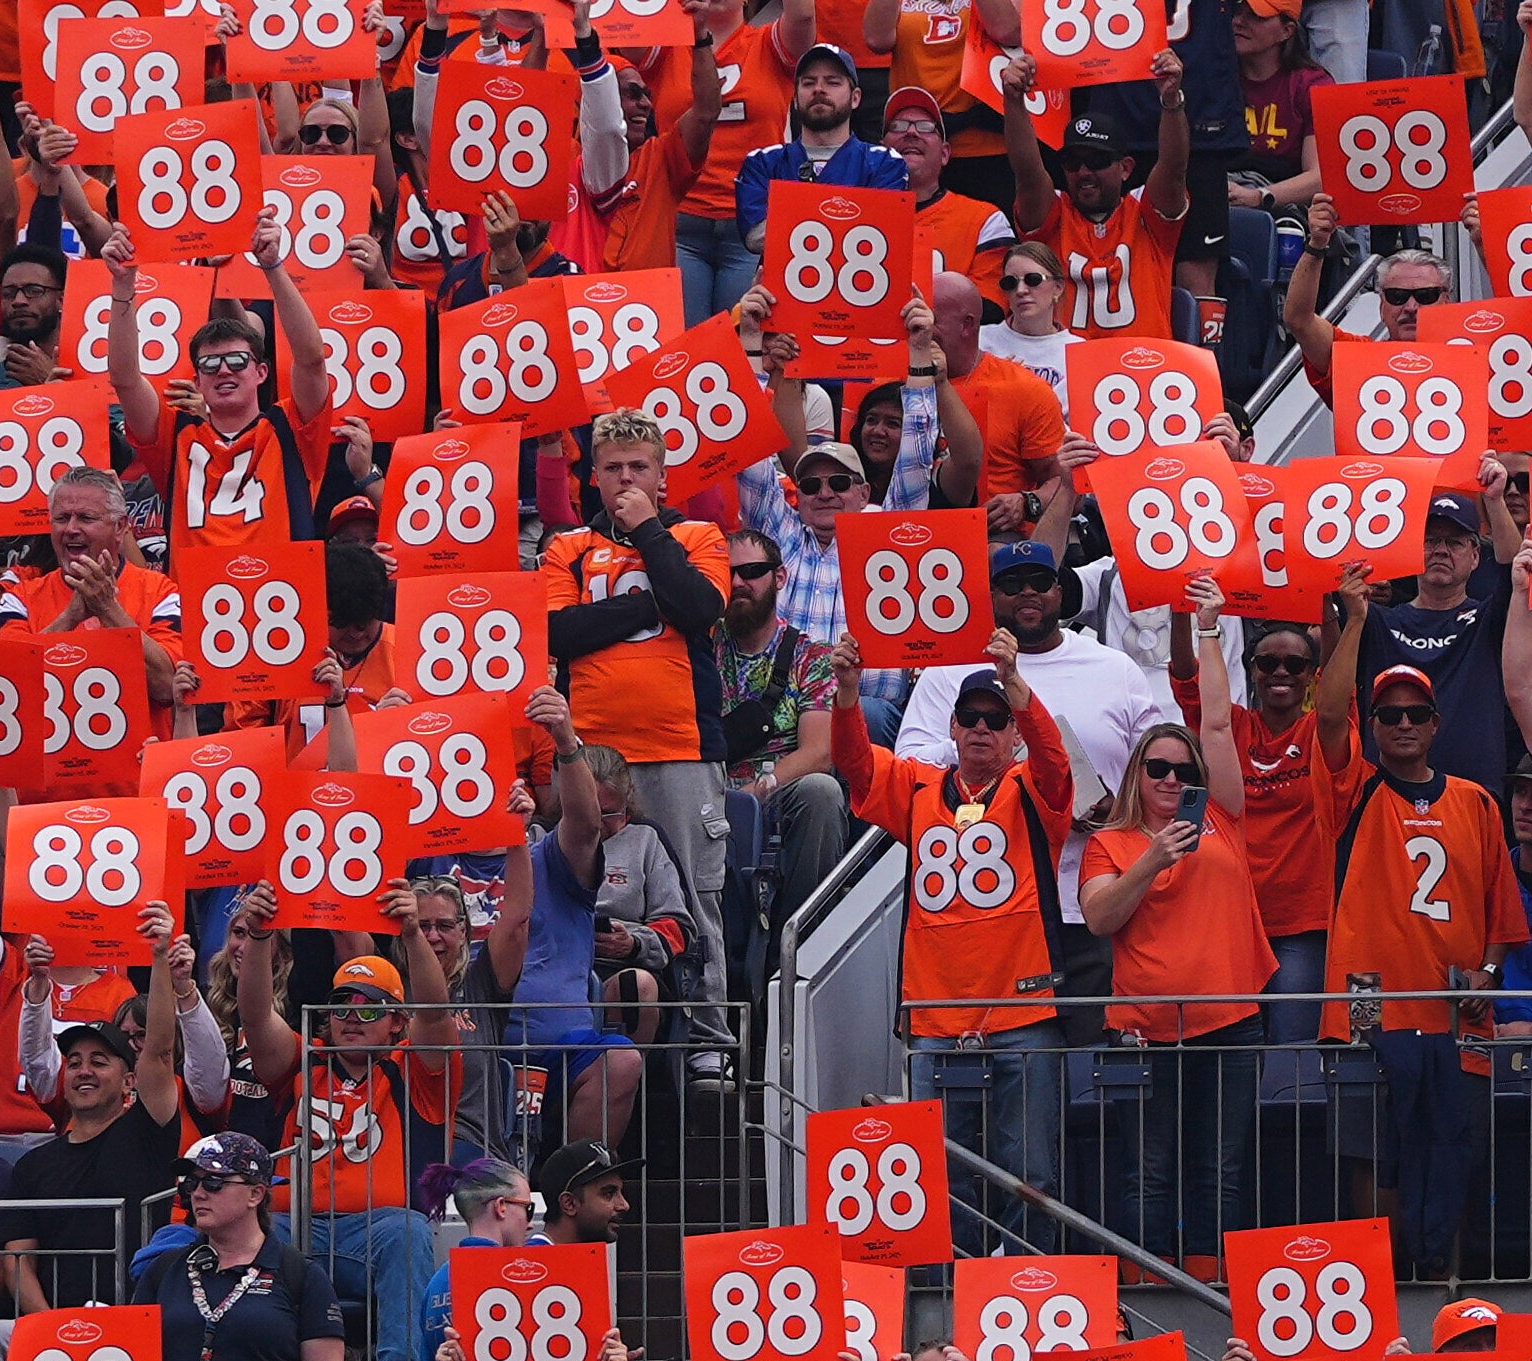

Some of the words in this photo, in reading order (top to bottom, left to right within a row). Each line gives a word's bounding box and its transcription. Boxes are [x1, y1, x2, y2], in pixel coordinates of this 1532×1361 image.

[138, 140, 241, 229] 88
[1339, 110, 1446, 192] 88
[865, 548, 969, 635] 88
[1011, 543, 1033, 556] KC
[1404, 818, 1442, 827] BRONCOS
[28, 824, 141, 906] 88
[913, 821, 1018, 913] 88
[1404, 836, 1451, 922] 2
[297, 1098, 384, 1164] 56
[711, 1266, 822, 1361] 88
